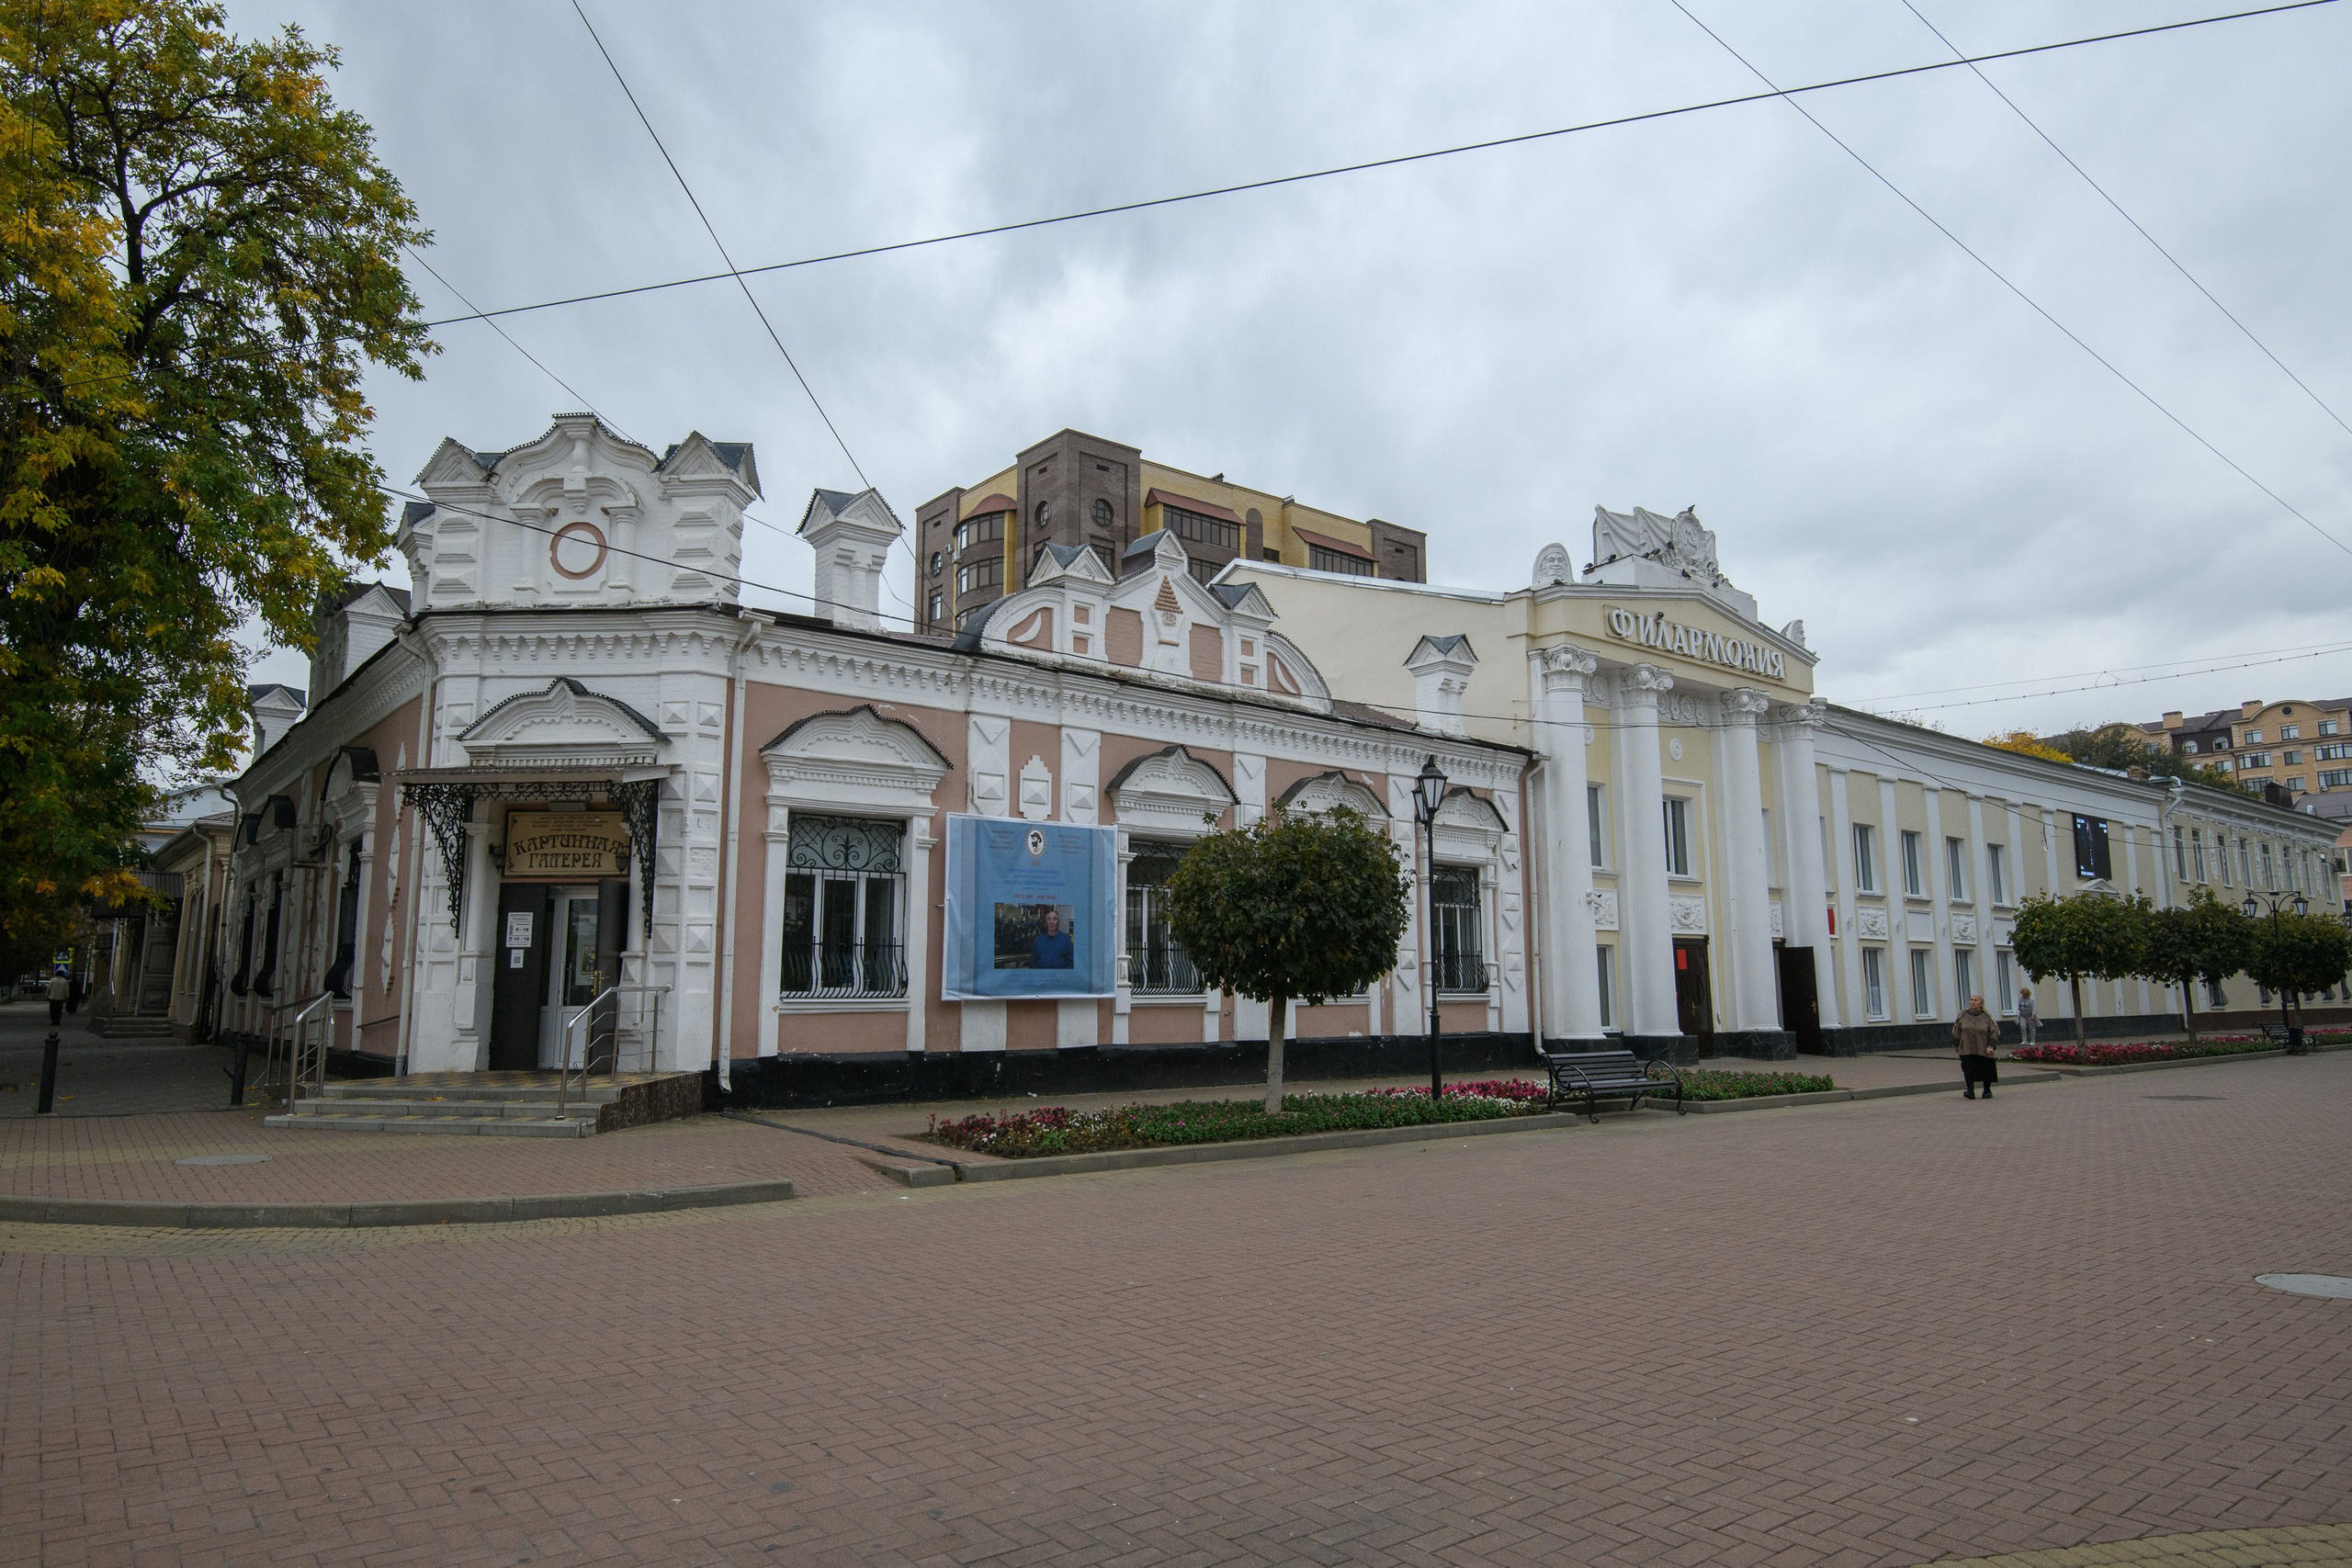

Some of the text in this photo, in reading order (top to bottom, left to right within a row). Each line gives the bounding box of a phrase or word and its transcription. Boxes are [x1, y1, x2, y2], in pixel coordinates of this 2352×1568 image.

[1608, 607, 1786, 680] ФИЛАРМОНИЯ
[513, 834, 624, 855] КАРТИННАЯ
[528, 852, 604, 868] ГАЛЕРЕЯ
